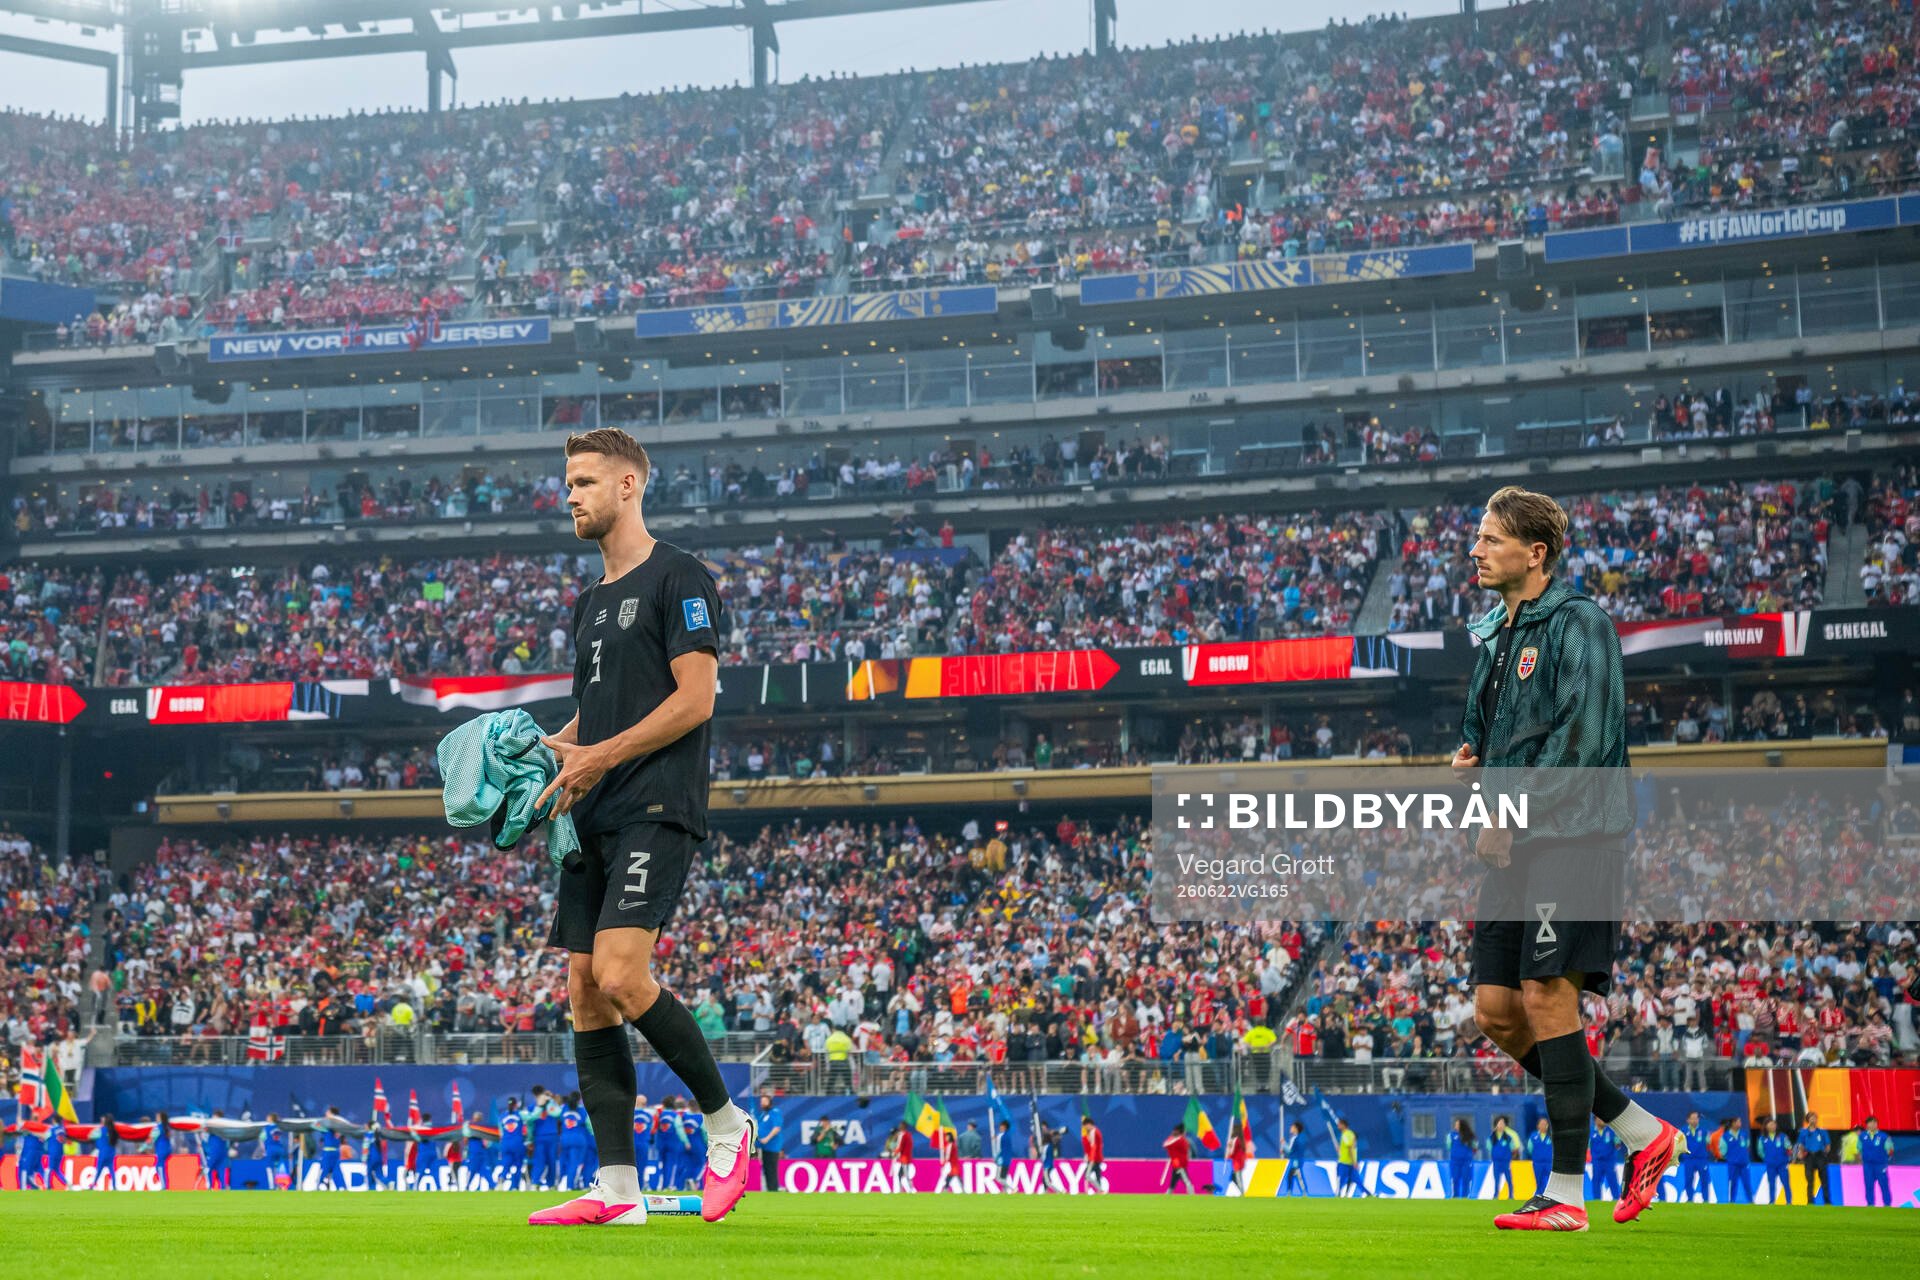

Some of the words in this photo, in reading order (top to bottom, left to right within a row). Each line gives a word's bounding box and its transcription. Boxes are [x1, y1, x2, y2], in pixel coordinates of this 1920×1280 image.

[1679, 207, 1847, 243] #FIFAWorldCup
[224, 338, 283, 355] NEW
[288, 334, 345, 351] YOR
[431, 323, 533, 343] JERSEY
[1704, 627, 1764, 647] NORWAY
[1823, 621, 1888, 640] SENEGAL
[590, 638, 603, 684] 3
[1140, 658, 1173, 676] EGAL
[1208, 654, 1249, 672] NORW
[110, 698, 139, 714] EGAL
[624, 851, 650, 893] 3
[1535, 902, 1557, 943] 8
[801, 1119, 867, 1145] FFA
[784, 1160, 918, 1194] QATAR
[933, 1161, 1110, 1195] AIRWAYS
[1314, 1160, 1446, 1199] VISA
